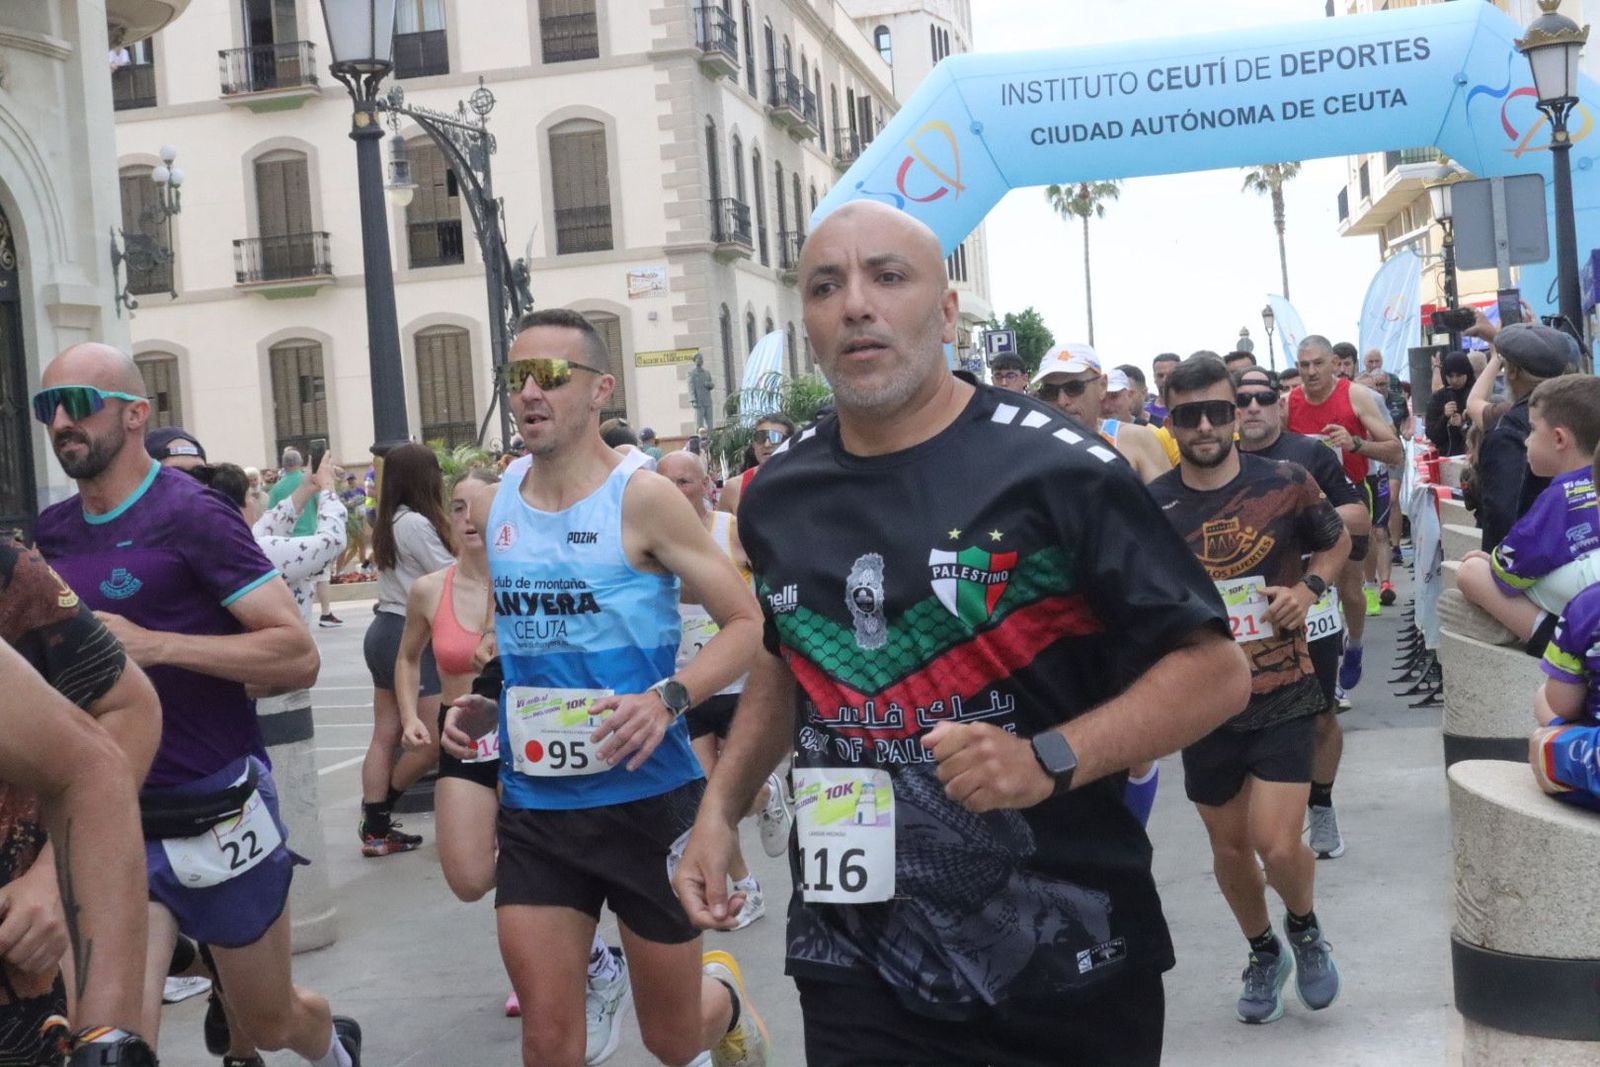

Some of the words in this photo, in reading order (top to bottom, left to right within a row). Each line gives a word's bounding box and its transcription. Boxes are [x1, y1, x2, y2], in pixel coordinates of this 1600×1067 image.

[1001, 71, 1138, 106] INSTITUTO
[1147, 56, 1226, 92] CEUTÍ
[1235, 56, 1272, 83] DE
[1280, 37, 1431, 77] DEPORTES
[1030, 120, 1124, 146] CIUDAD
[1130, 103, 1275, 138] AUTÓNOMA
[1282, 99, 1315, 120] DE
[1323, 88, 1408, 115] CEUTA
[991, 333, 1008, 353] P
[515, 577, 531, 589] de
[534, 577, 587, 590] montaña
[932, 566, 1009, 584] PALESTINO
[515, 620, 569, 640] CEUTA
[1307, 615, 1337, 637] 201
[566, 697, 587, 710] 10K
[548, 740, 589, 769] 95
[824, 781, 854, 800] 10K
[221, 830, 264, 871] 22
